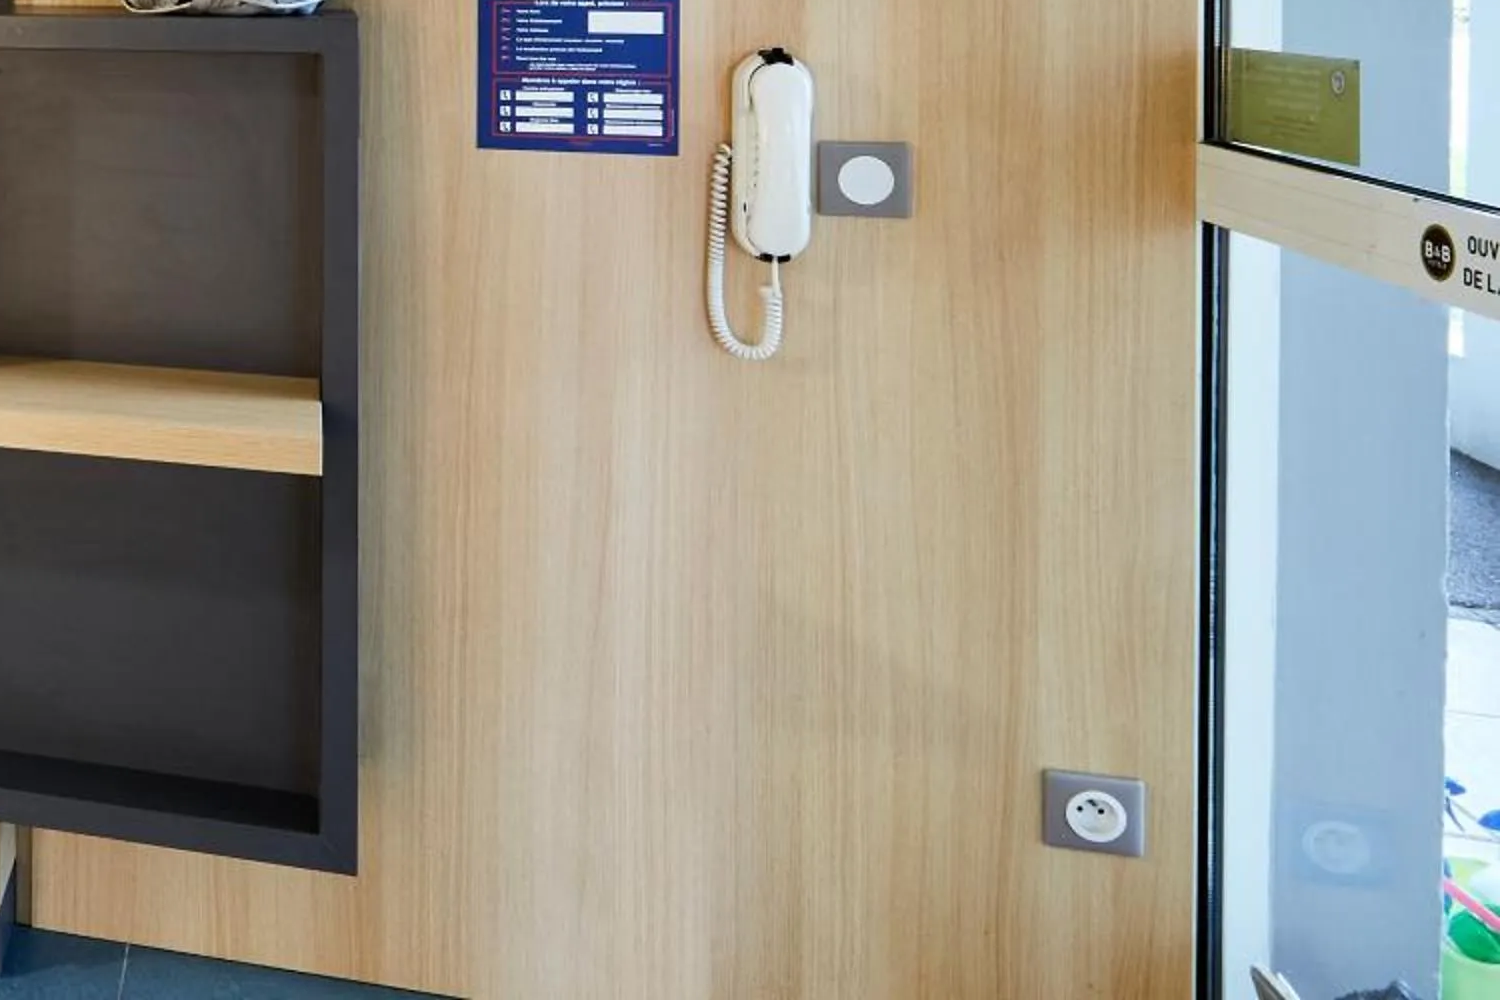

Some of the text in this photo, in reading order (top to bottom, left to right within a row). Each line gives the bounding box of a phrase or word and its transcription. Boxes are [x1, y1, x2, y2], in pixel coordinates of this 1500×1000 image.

[1425, 240, 1451, 263] B&B
[1463, 267, 1500, 297] DE L
